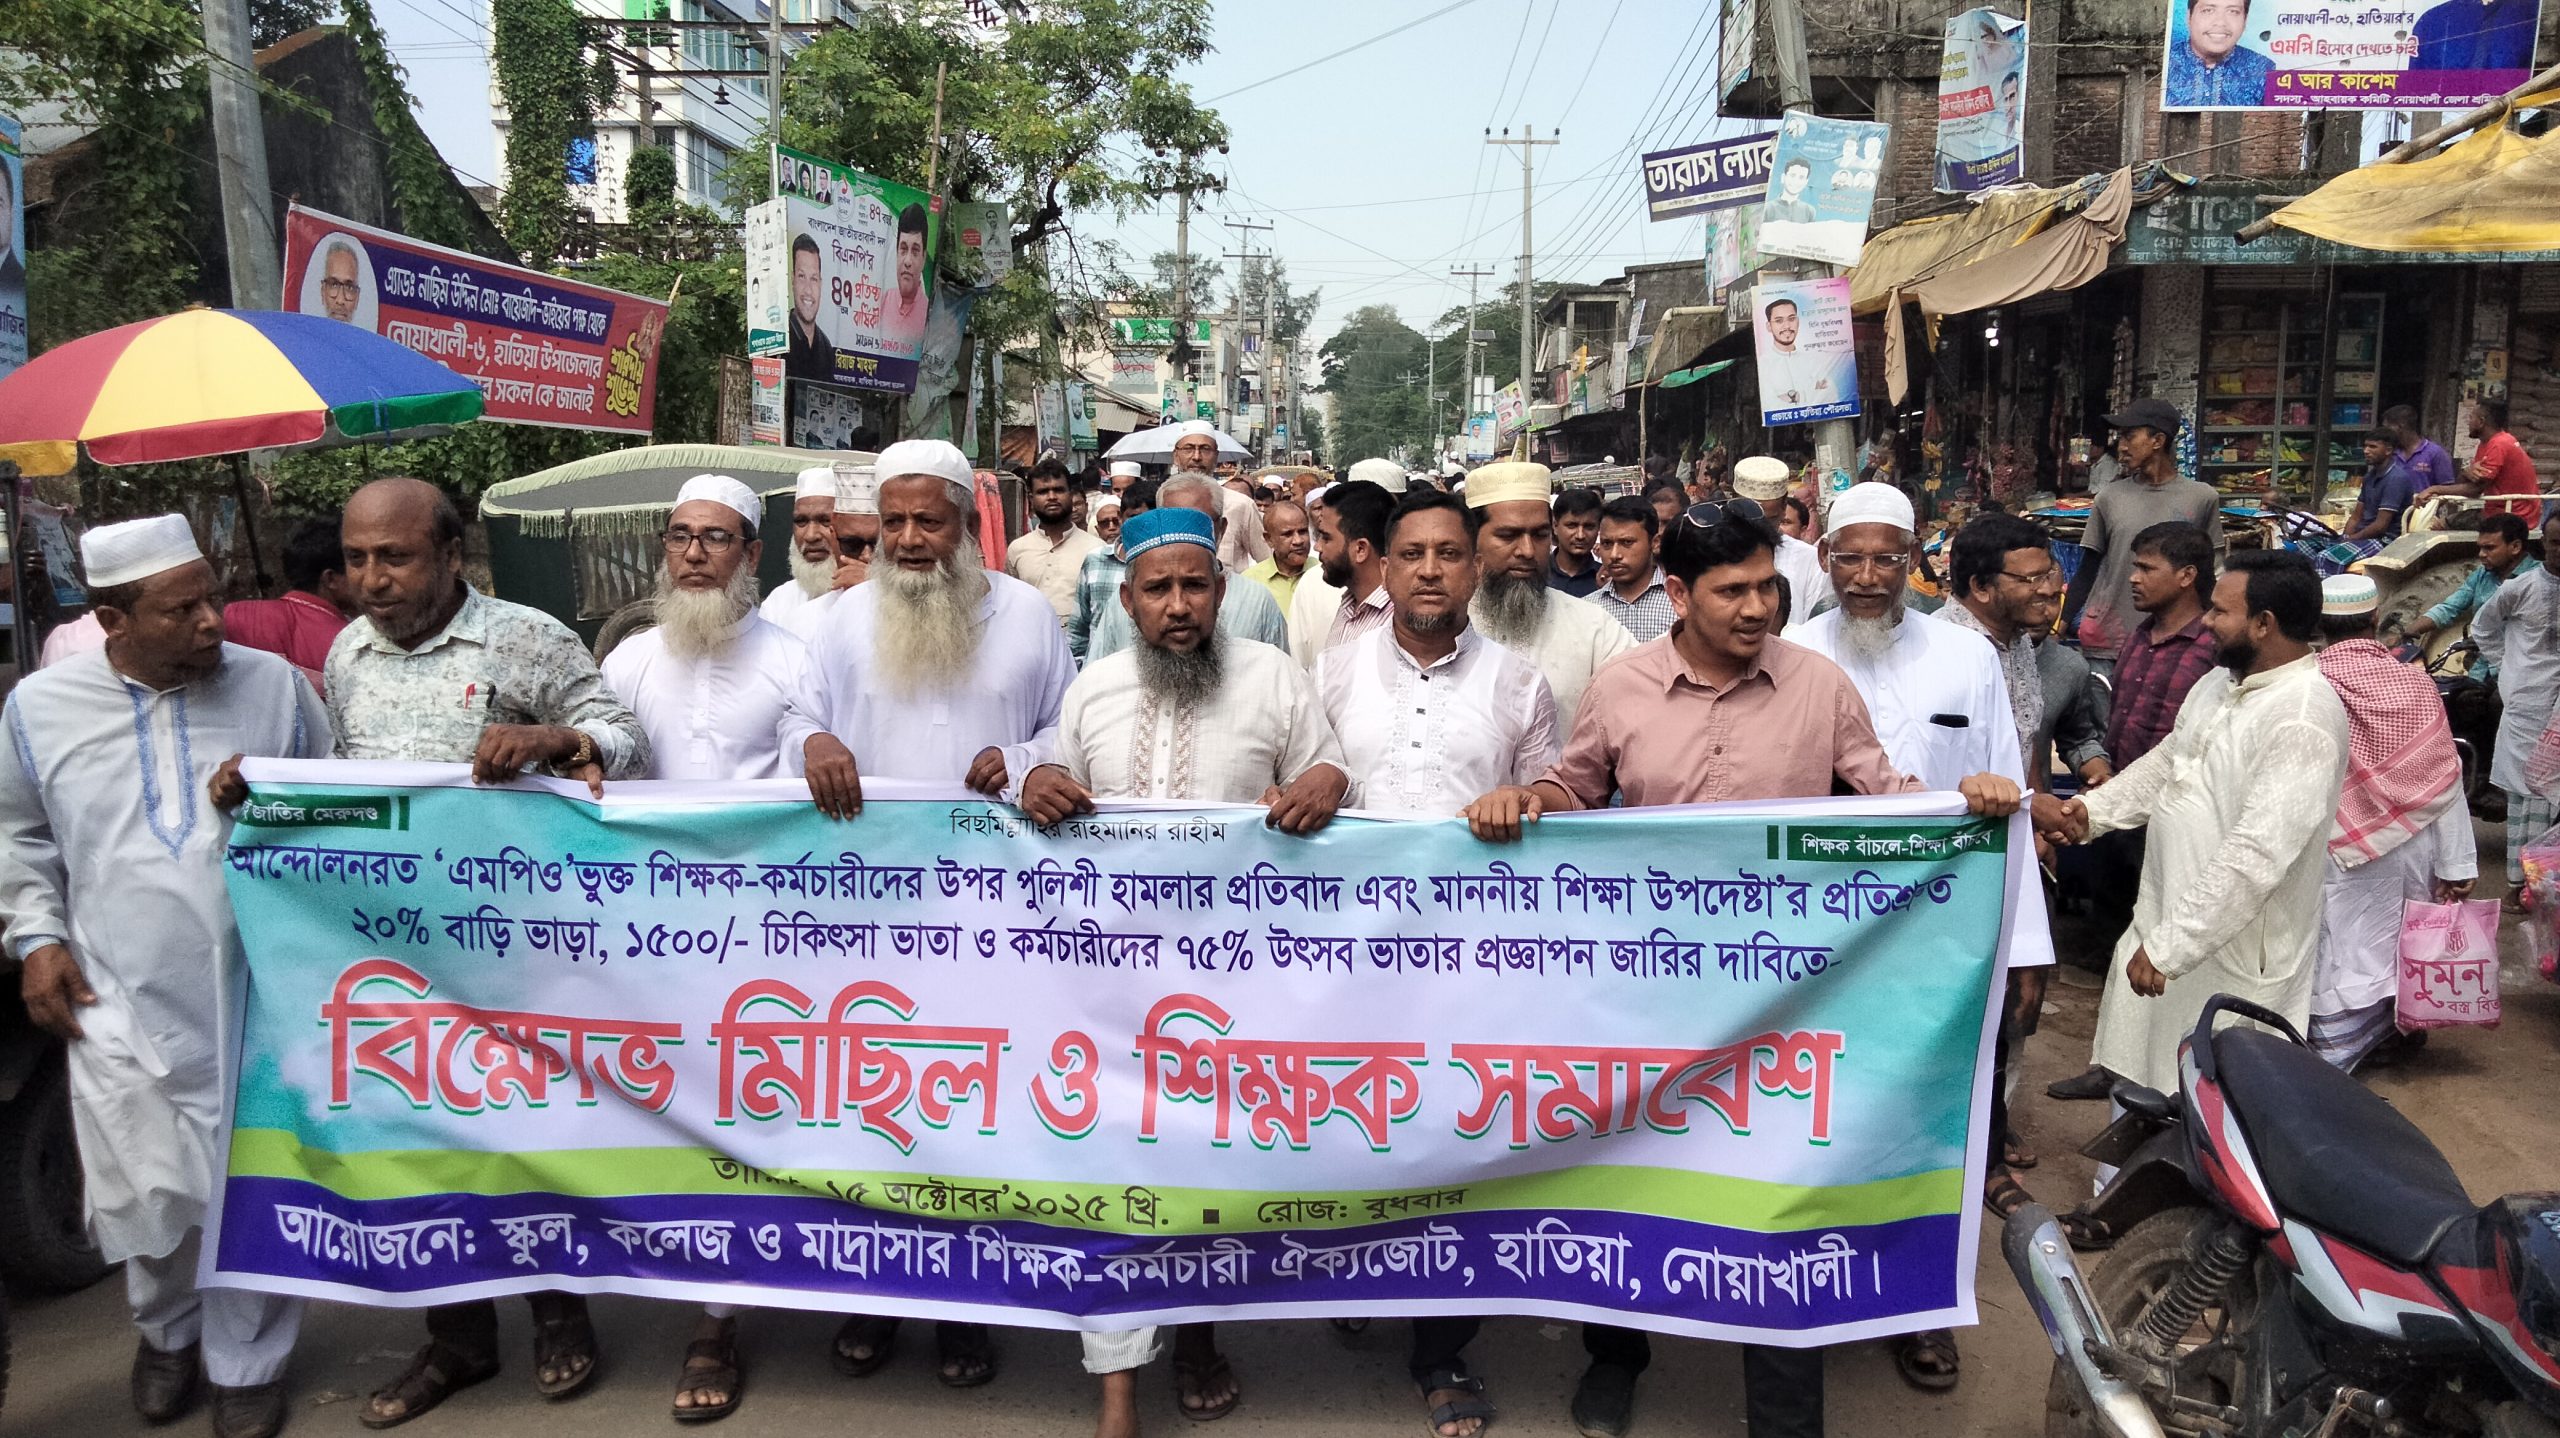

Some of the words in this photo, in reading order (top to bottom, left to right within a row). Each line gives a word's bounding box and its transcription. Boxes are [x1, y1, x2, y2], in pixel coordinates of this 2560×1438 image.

[2270, 33, 2313, 56] এমপি
[2315, 39, 2354, 57] হিসেবে
[2355, 42, 2395, 58] দেখতে
[2395, 34, 2419, 58] চাই
[2276, 73, 2292, 90] এ
[2298, 73, 2334, 91] আর
[2339, 73, 2400, 91] কাশেম
[2359, 92, 2391, 105] কমিটি
[2393, 92, 2442, 106] নোয়াখালী
[1646, 149, 1718, 194] তারাস
[807, 216, 837, 236] বাংলাদেশ
[869, 203, 881, 223] ৪৭
[418, 265, 449, 310] নাছিম
[451, 272, 479, 314] উদ্দিন
[480, 287, 500, 317] মোঃ
[572, 307, 587, 333] পক্ষ
[588, 311, 606, 338] থেকে
[831, 276, 853, 307] ৪৭
[494, 333, 538, 372] হাতিয়া
[540, 341, 604, 381] উপজেলার
[495, 377, 535, 406] সকল
[535, 384, 556, 408] কে
[556, 383, 595, 415] জানাই
[251, 800, 306, 823] জাতির
[1066, 818, 1160, 844] রাহমানির
[1167, 815, 1228, 845] রাহীম
[1801, 833, 1851, 856] শিক্ষক
[227, 842, 424, 888] আন্দোলনরত
[645, 849, 926, 902] শিক্ষক-কর্মচারীদের
[933, 854, 1008, 903] উপর
[1016, 856, 1103, 915] পুলিশী
[1108, 867, 1218, 915] হামলার
[1226, 861, 1345, 917] প্রতিবাদ
[1355, 872, 1422, 917] এবং
[1429, 860, 1545, 914] মাননীয়
[1551, 862, 1638, 916] শিক্ষা
[351, 906, 430, 946] ২০%
[440, 904, 515, 959] বাড়ি
[520, 917, 608, 966] ভাড়া,
[626, 915, 749, 965] ১৫০০/-
[760, 909, 882, 961] চিকিৎসা
[888, 920, 963, 963] ভাতা
[973, 924, 997, 961] ও
[1006, 916, 1164, 971] কর্মচারীদের
[1176, 928, 1254, 974] ৭৫%
[1266, 922, 1358, 976] উৎসব
[1365, 933, 1466, 976] ভাতার
[1475, 933, 1600, 978] প্রজ্ঞাপন
[1606, 927, 1706, 980] জারির
[2402, 956, 2491, 1009] সুমন
[318, 956, 684, 1114] বিক্ষোভ
[707, 977, 1012, 1158] মিছিল
[1027, 1026, 1103, 1142] ও
[1133, 990, 1430, 1152] শিক্ষক
[1448, 1027, 1847, 1153] সমাবেশ
[1363, 1187, 1470, 1221] বুধবার
[489, 1212, 590, 1270] স্কুল,
[599, 1216, 737, 1266] কলেজ
[748, 1221, 782, 1262] ও
[795, 1217, 959, 1282] মাদ্রাসার
[965, 1224, 1256, 1293] শিক্ষক-কর্মচারী
[1271, 1221, 1475, 1288] ঐক্যজোট,
[1489, 1216, 1642, 1302] হাতিয়া,
[1662, 1231, 1860, 1307] নোয়াখালী
